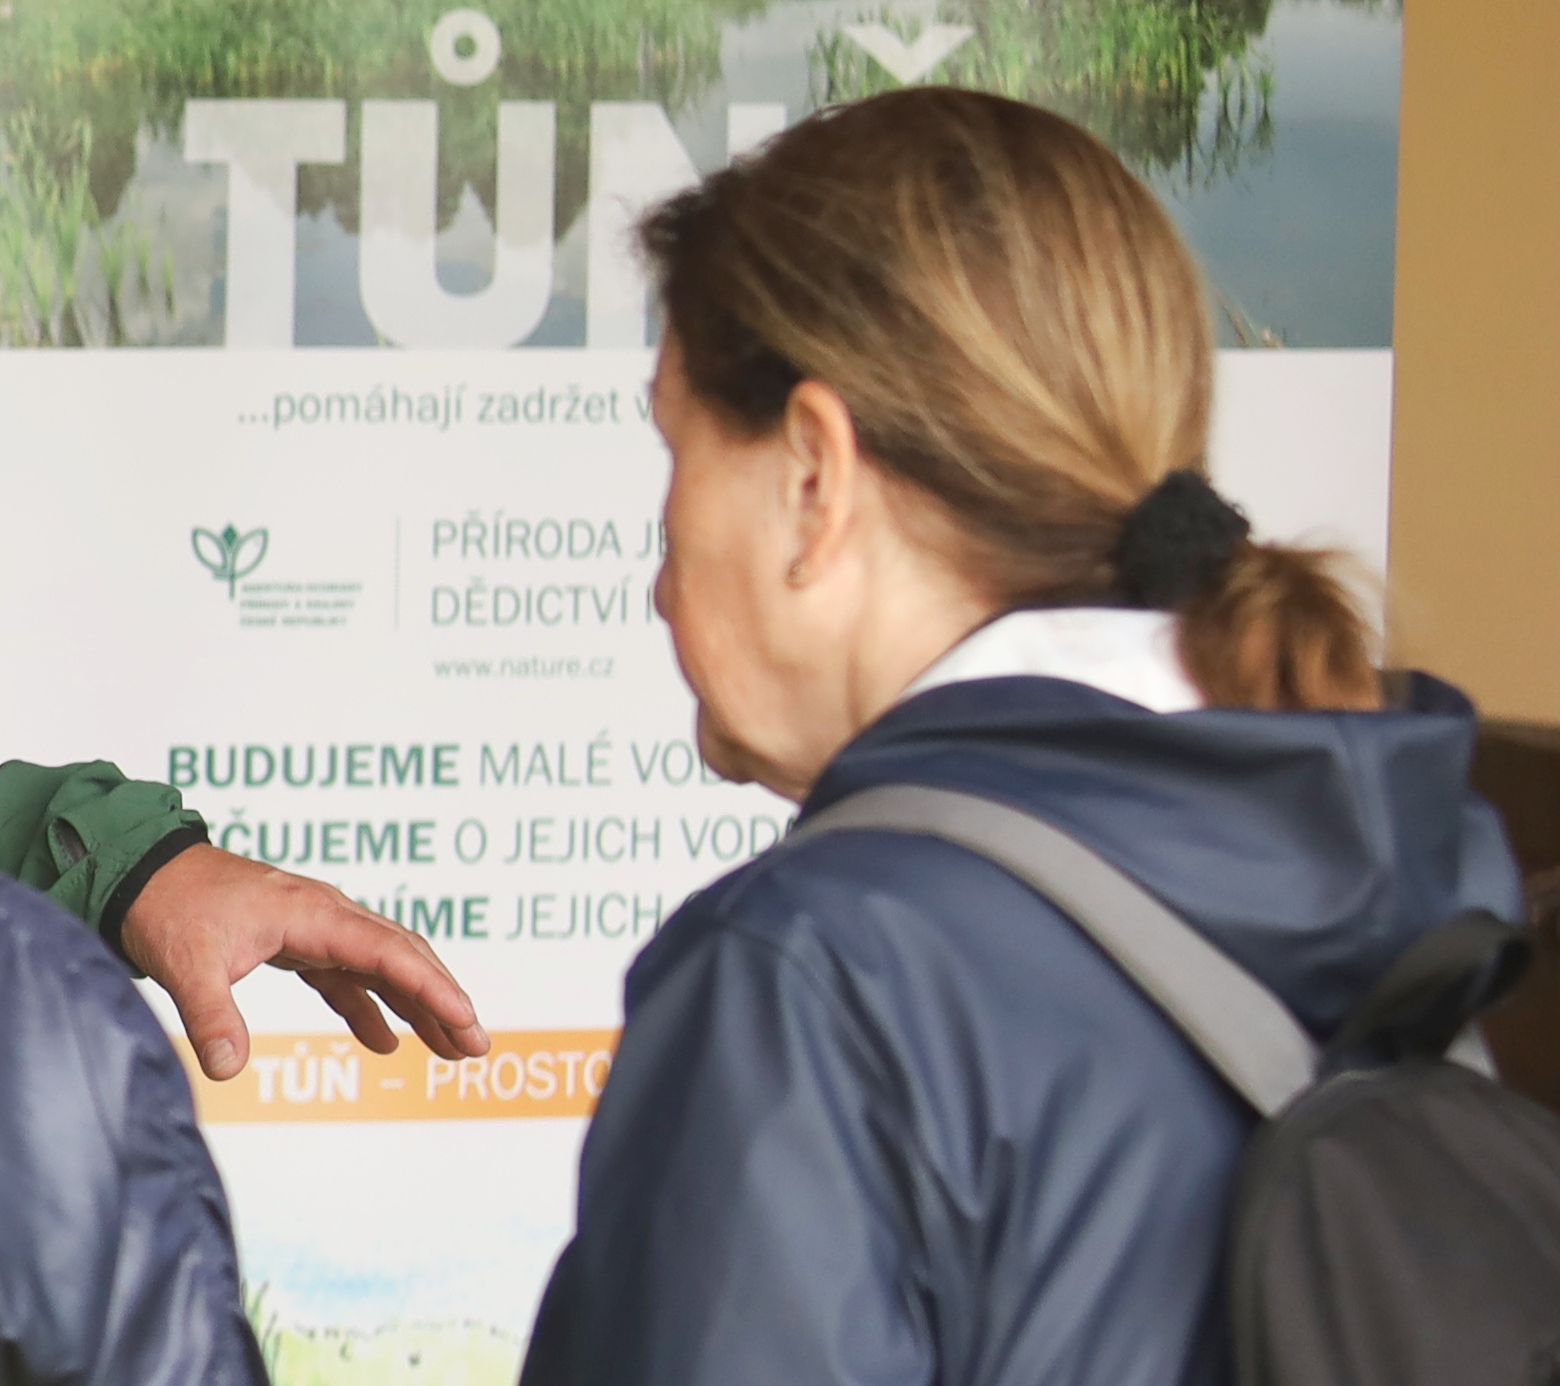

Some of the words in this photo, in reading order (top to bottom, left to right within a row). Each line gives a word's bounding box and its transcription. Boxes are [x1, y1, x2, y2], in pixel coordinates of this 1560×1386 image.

[184, 9, 975, 348] TŮN
[477, 383, 621, 424] zadržet
[432, 507, 622, 559] PŘÍRODA
[431, 575, 632, 626] DĚDICTVÍ
[433, 654, 615, 678] www.nature.cz
[168, 744, 460, 788] BUDUJEME
[480, 729, 612, 785] MALÉ
[206, 807, 436, 864] ČUJEME
[454, 818, 488, 863] O
[505, 816, 661, 863] JEJICH
[680, 815, 796, 863] VOD
[505, 892, 662, 940] JEJICH
[252, 1041, 360, 1104] TŮŇ
